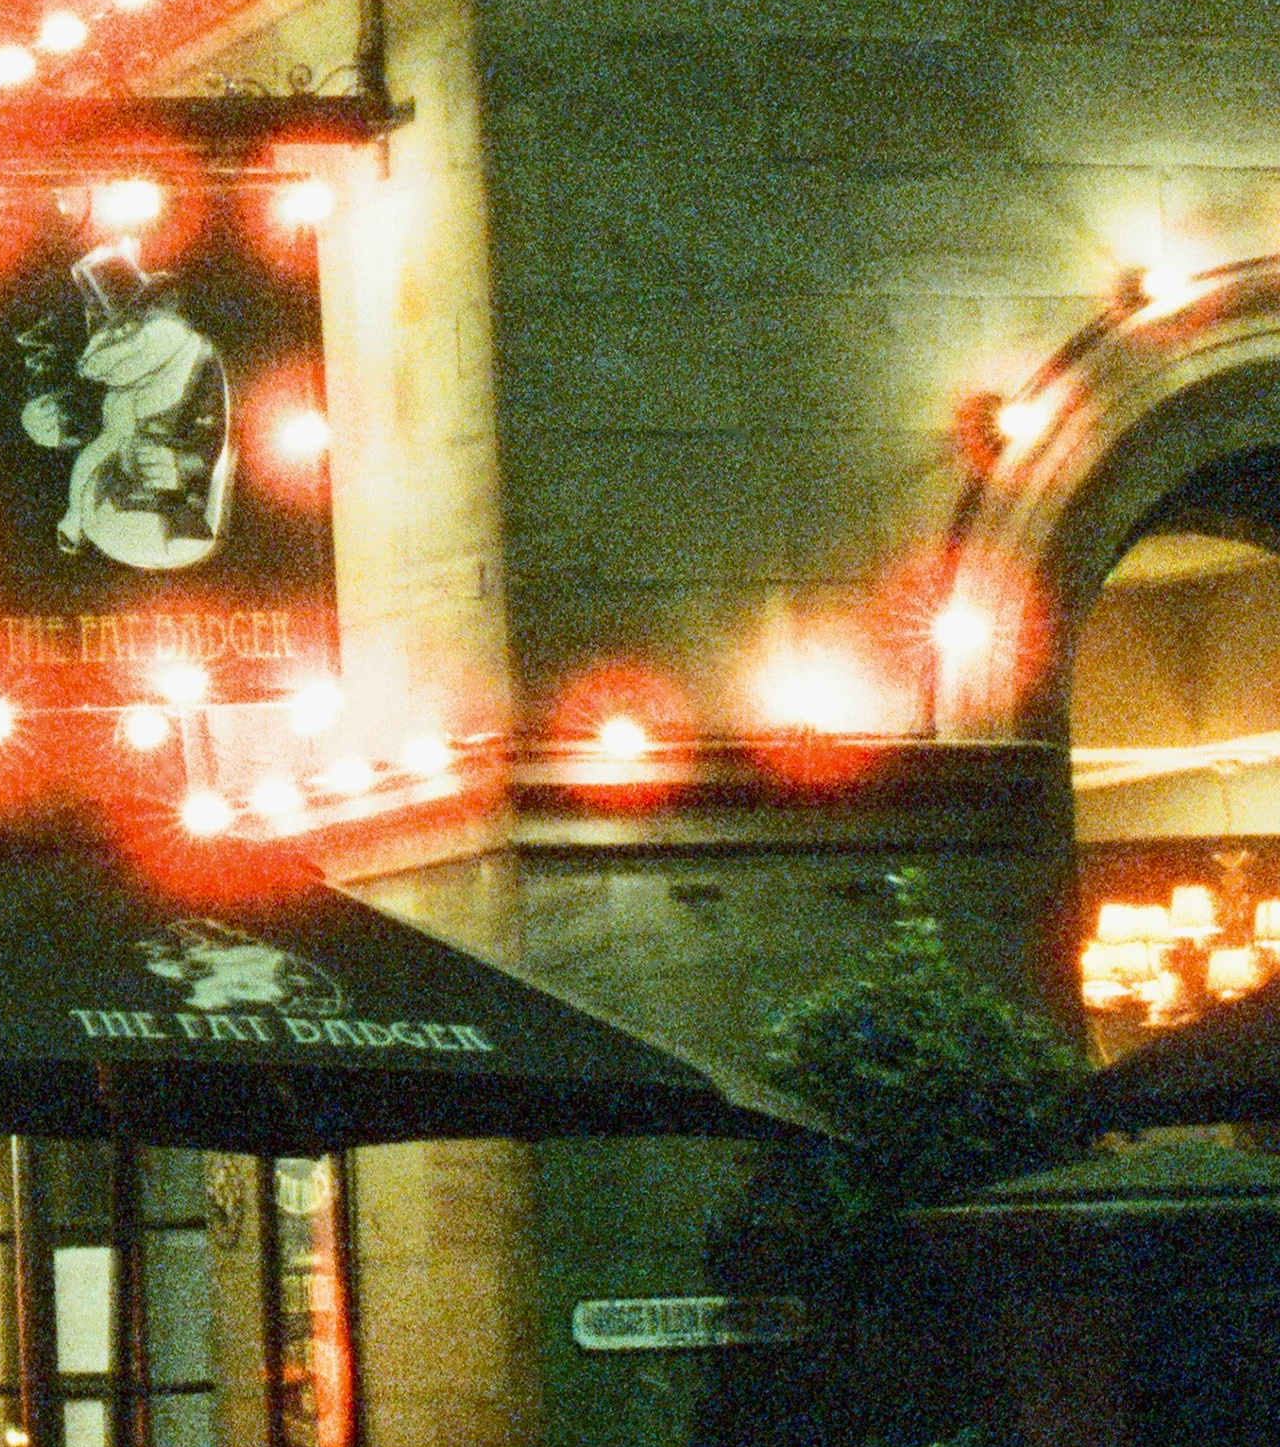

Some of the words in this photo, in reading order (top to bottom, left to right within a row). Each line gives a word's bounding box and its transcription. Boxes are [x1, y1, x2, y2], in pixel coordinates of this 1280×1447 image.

[2, 614, 68, 666] THE
[78, 612, 140, 663] FAT
[152, 609, 298, 662] BADGER
[68, 1009, 168, 1040] THE
[174, 1012, 274, 1042] FAT
[280, 1015, 495, 1053] BADGER
